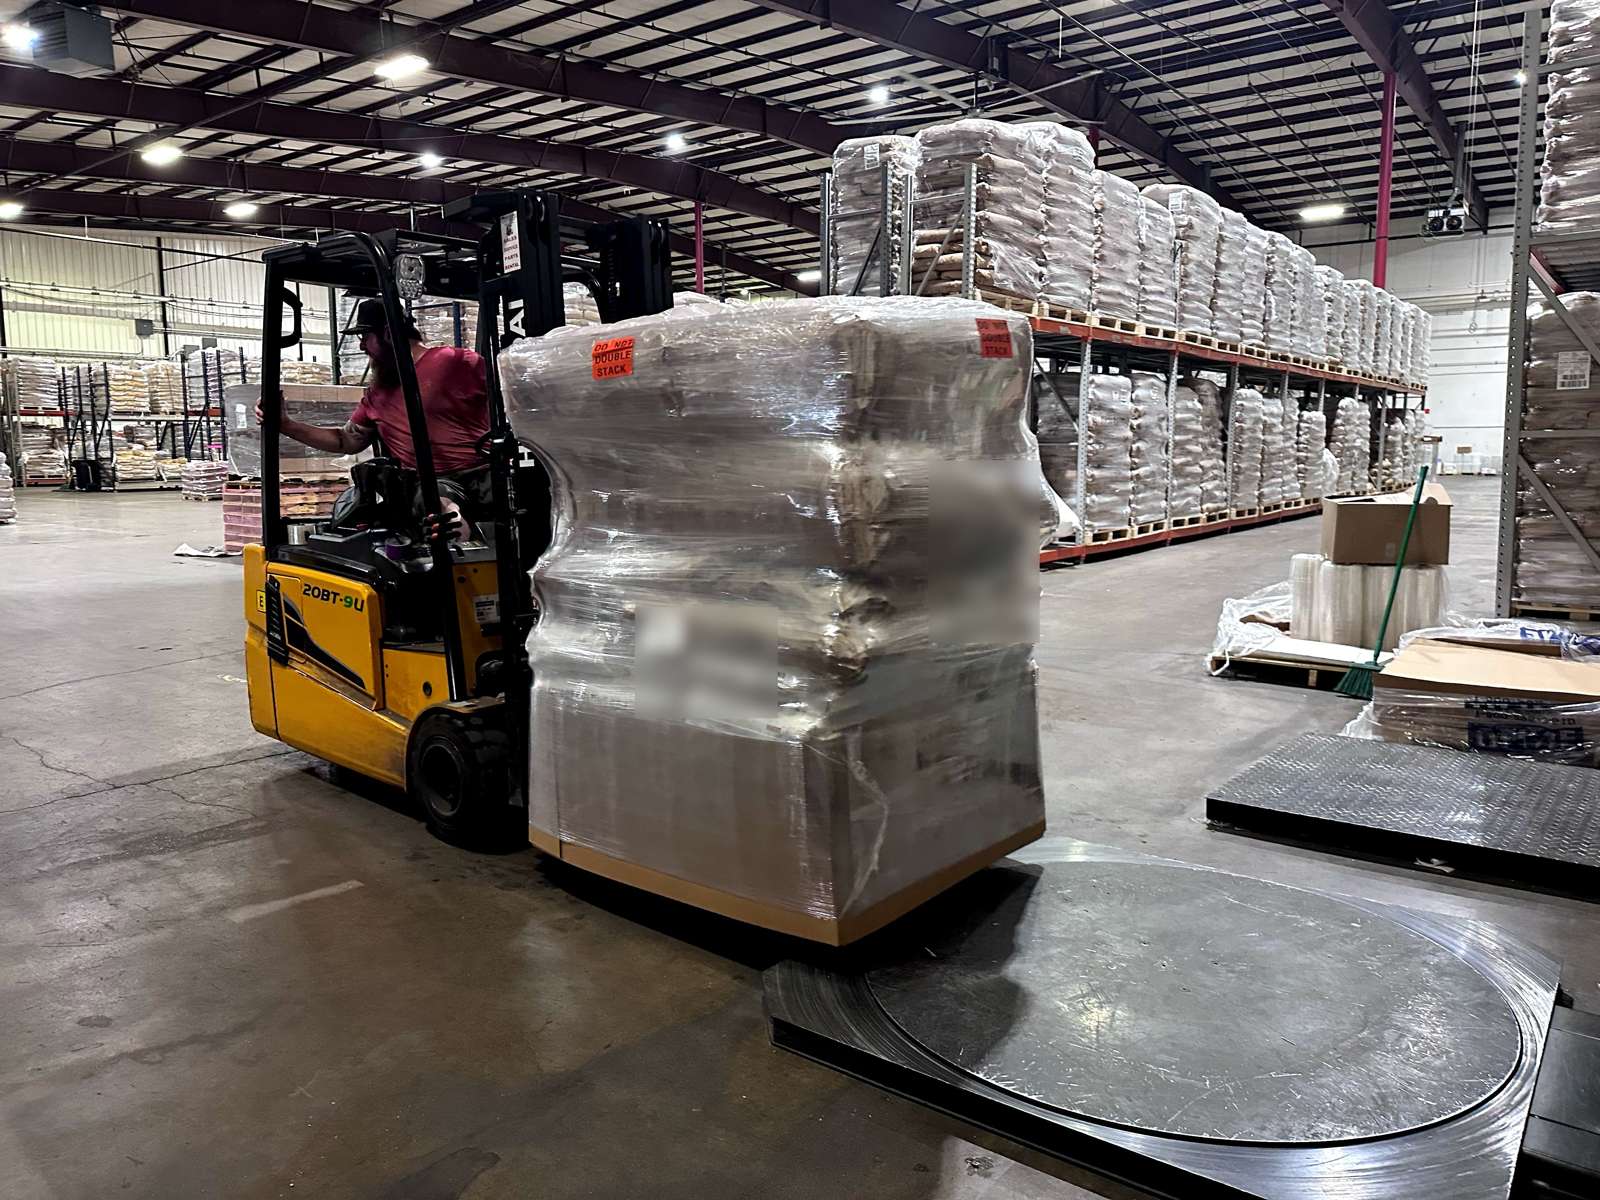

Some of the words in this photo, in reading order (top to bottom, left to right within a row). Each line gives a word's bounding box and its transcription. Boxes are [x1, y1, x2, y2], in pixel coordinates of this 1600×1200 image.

[504, 253, 519, 261] PARTS
[504, 262, 520, 270] RENTAL
[594, 343, 608, 352] DO
[614, 339, 633, 348] NOT
[594, 350, 632, 364] DOUBLE
[597, 364, 626, 377] STACK
[302, 583, 365, 612] 20BT-9U
